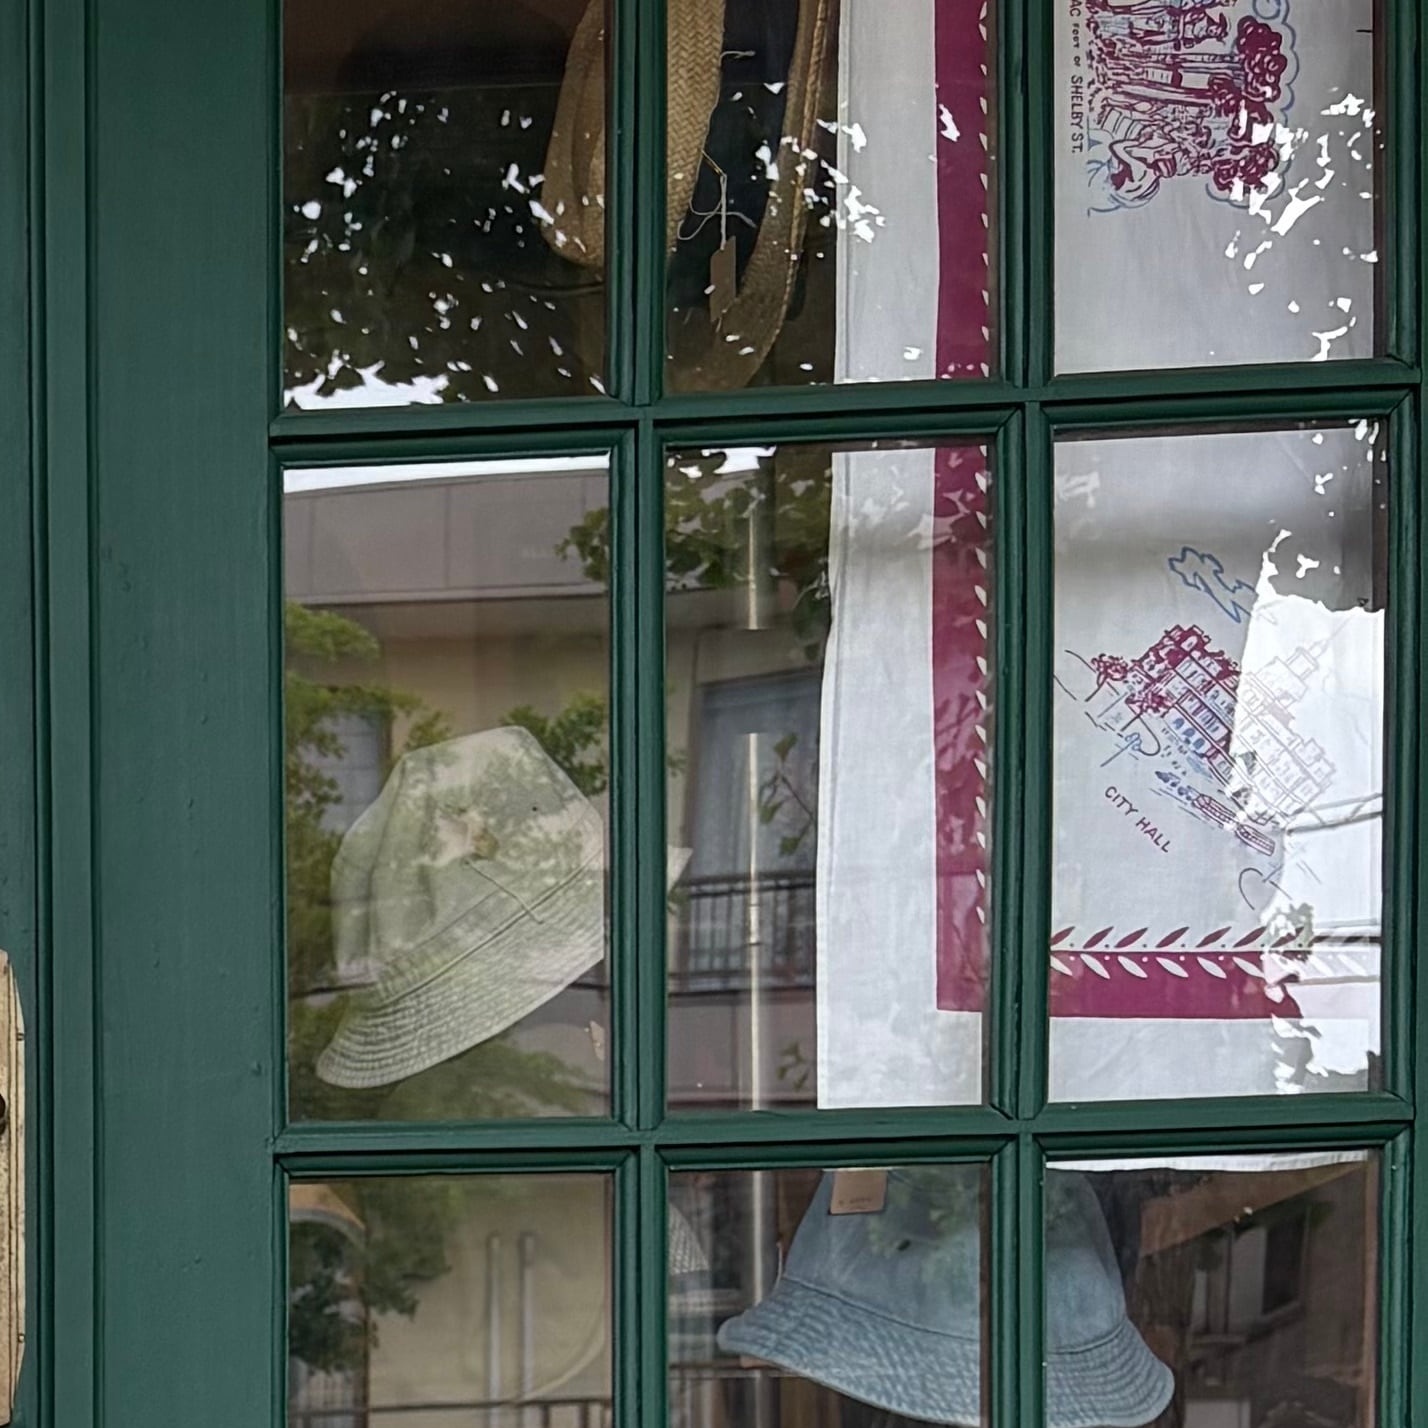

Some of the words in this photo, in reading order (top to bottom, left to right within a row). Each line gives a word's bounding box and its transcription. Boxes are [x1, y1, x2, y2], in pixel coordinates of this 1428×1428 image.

[1070, 75, 1084, 130] SHELBY
[1071, 133, 1084, 154] ST.
[1104, 785, 1139, 816] CITY
[1135, 816, 1171, 853] HALL
